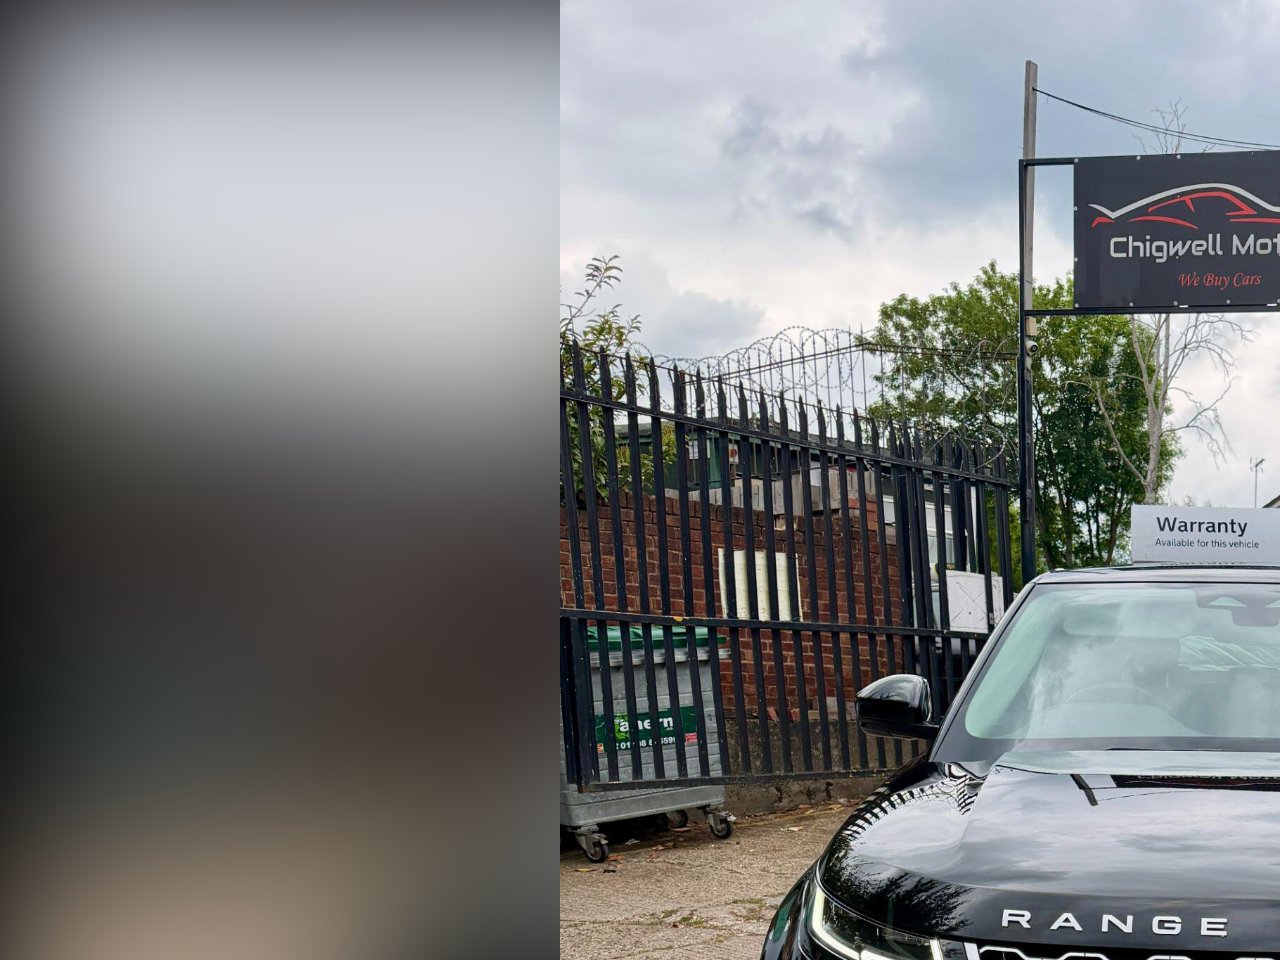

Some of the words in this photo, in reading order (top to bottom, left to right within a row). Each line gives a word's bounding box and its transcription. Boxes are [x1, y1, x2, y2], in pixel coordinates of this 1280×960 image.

[1110, 233, 1223, 263] Chigwell
[1178, 272, 1200, 287] We
[1203, 272, 1230, 290] Buy
[1233, 272, 1261, 287] Cars
[1156, 516, 1248, 537] Warranty
[1155, 538, 1194, 548] Available
[1197, 538, 1210, 548] for
[1211, 538, 1227, 548] this
[1229, 539, 1260, 549] vehicle
[1001, 908, 1229, 938] RANGE
